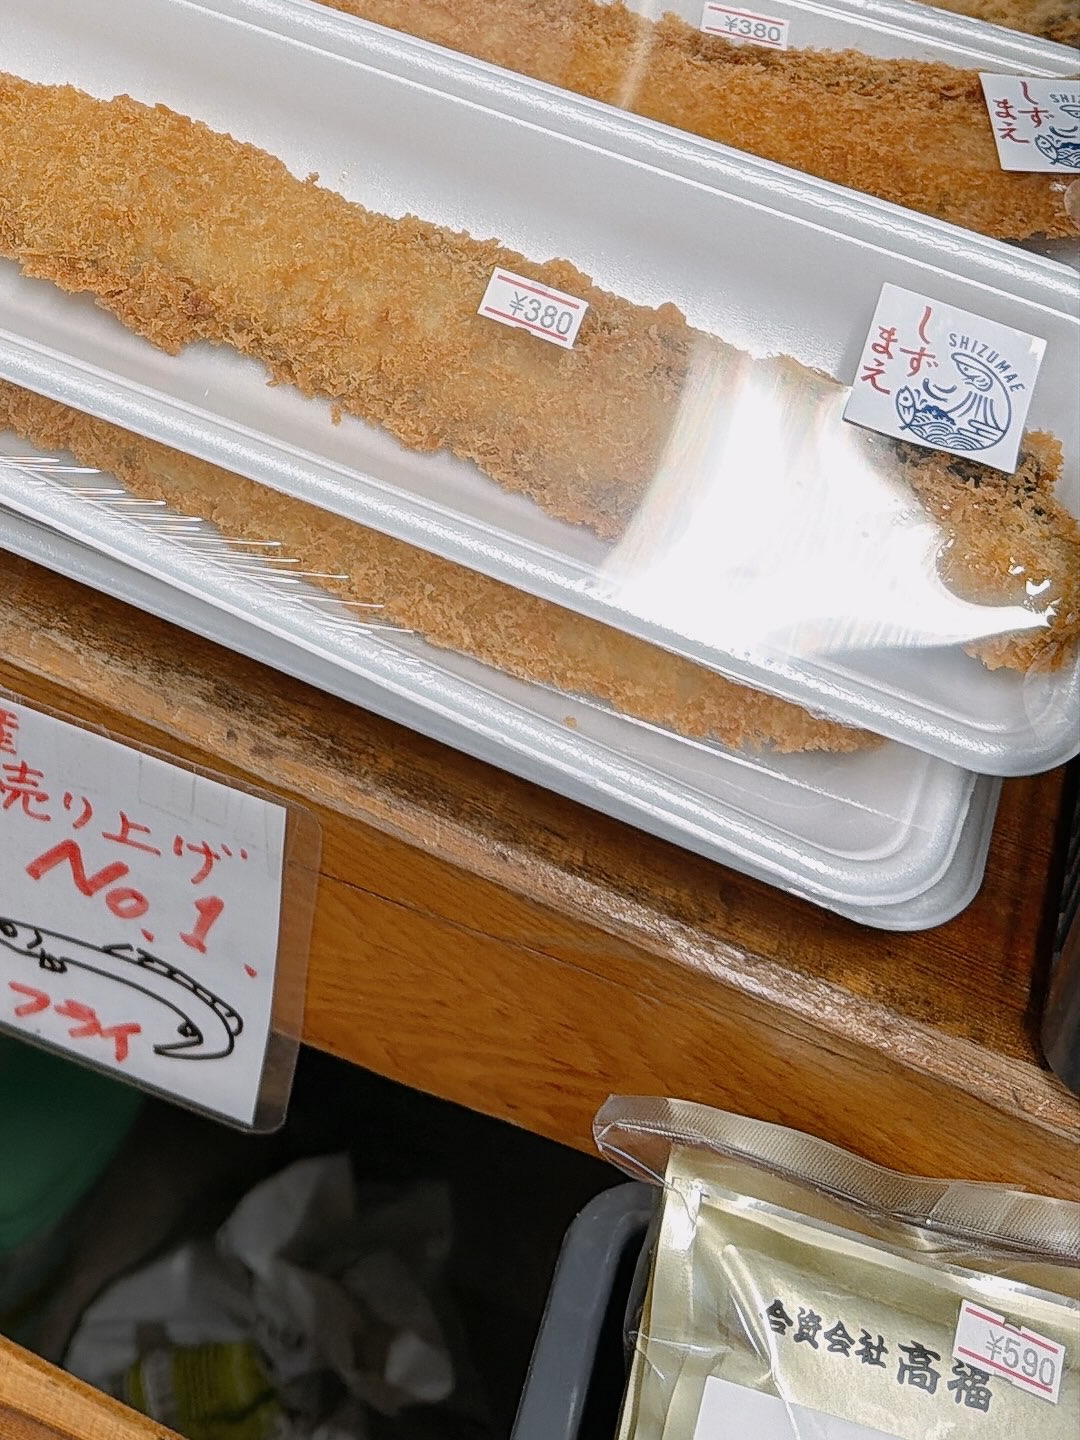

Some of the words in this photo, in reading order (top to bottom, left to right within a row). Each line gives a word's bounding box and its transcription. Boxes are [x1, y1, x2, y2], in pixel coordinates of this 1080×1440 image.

[724, 15, 781, 42] ¥380
[1049, 93, 1080, 104] SHI
[509, 289, 575, 339] ¥380
[948, 332, 1026, 393] SHIZUMAE
[9, 982, 142, 1063] フライ
[984, 1329, 1057, 1387] ¥590
